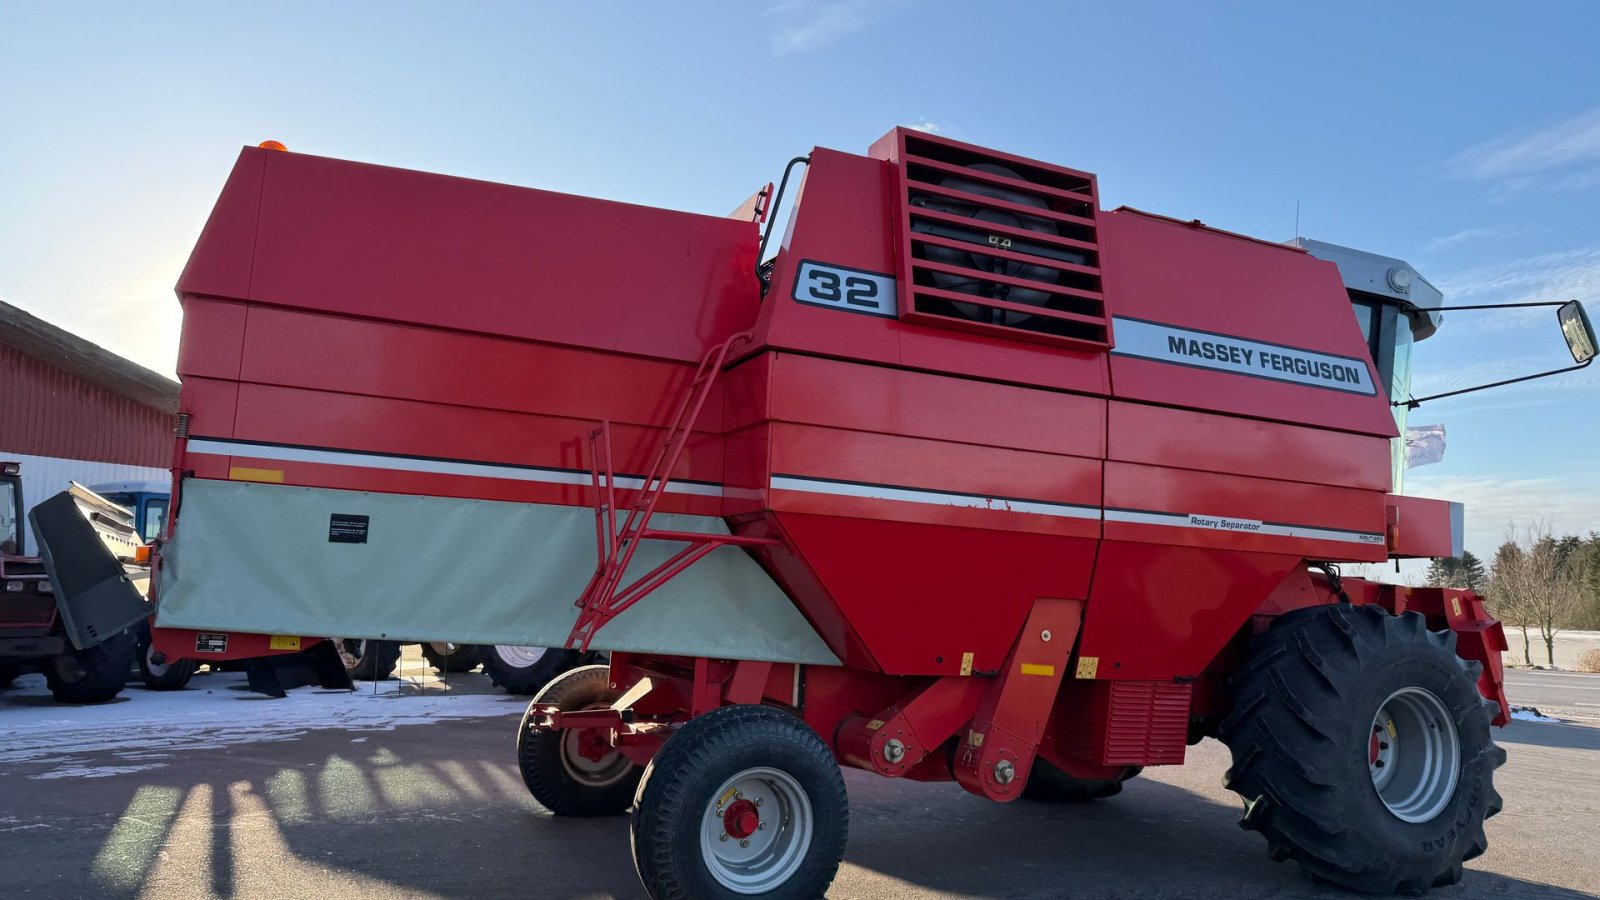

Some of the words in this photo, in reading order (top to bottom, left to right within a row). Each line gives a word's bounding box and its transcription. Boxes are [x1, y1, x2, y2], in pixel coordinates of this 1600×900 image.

[808, 269, 880, 309] 32
[1167, 335, 1253, 366] MASSEY
[1259, 351, 1360, 385] FERGUSON
[1190, 516, 1219, 529] Rotary
[1220, 519, 1261, 531] Separator
[1421, 758, 1481, 852] OODYEAR
